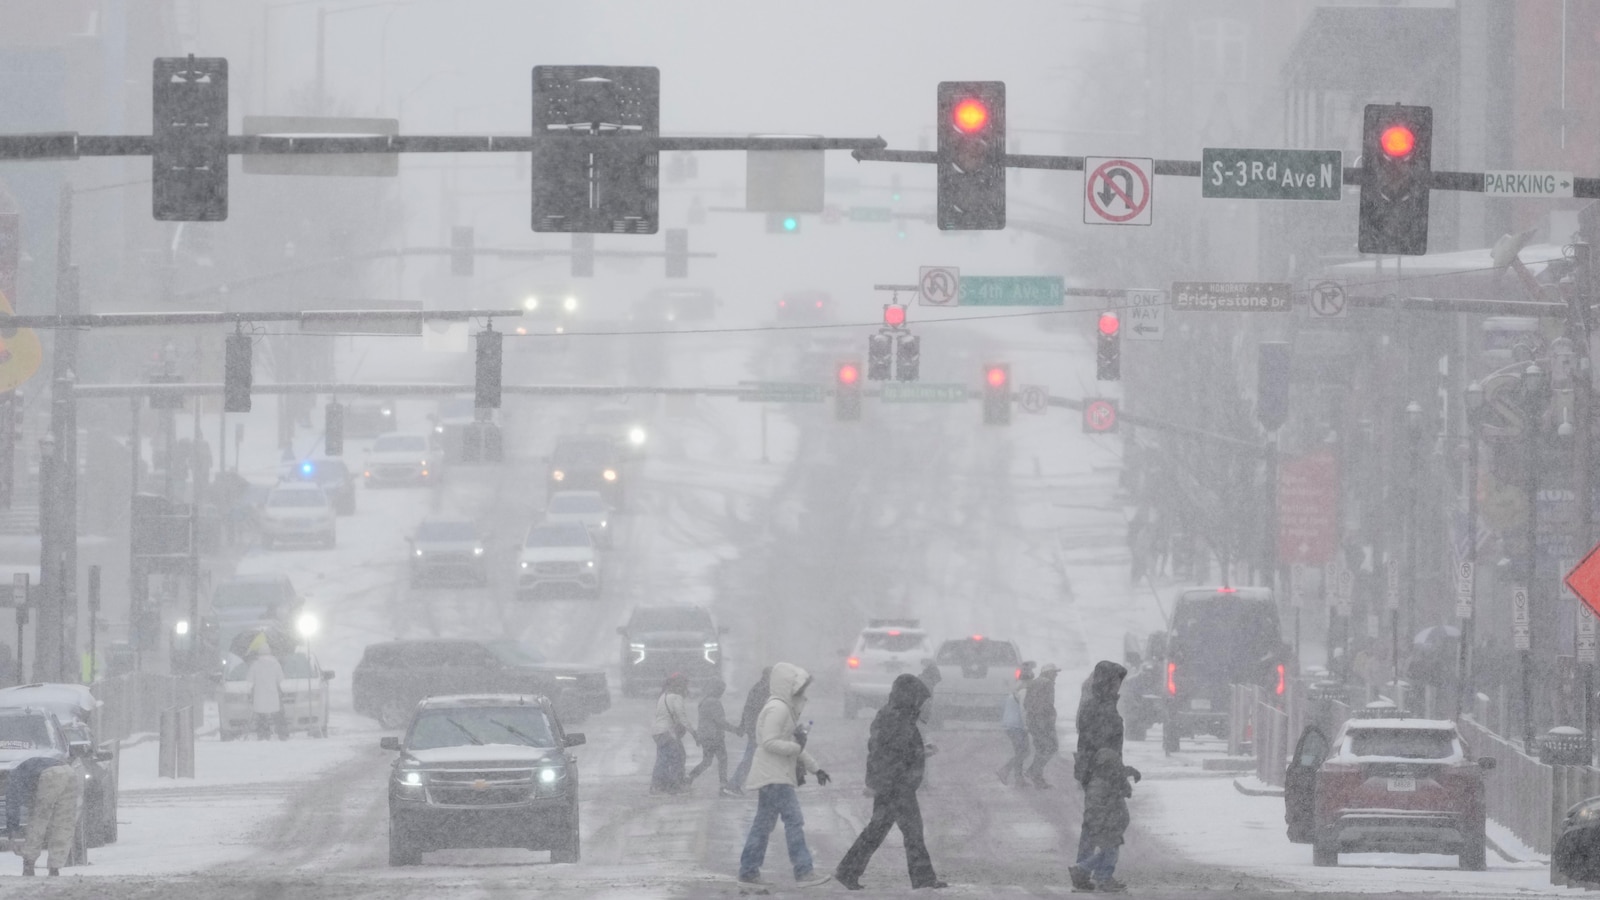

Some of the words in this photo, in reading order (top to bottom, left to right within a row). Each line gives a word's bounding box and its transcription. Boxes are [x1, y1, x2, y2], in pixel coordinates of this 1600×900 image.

[1320, 164, 1333, 189] N
[1485, 173, 1556, 195] PARKING
[1209, 283, 1249, 293] HONORARY
[1133, 294, 1160, 306] ONE
[1177, 292, 1269, 309] Bridgestone
[1270, 297, 1286, 308] Dr
[1131, 308, 1160, 320] WAY
